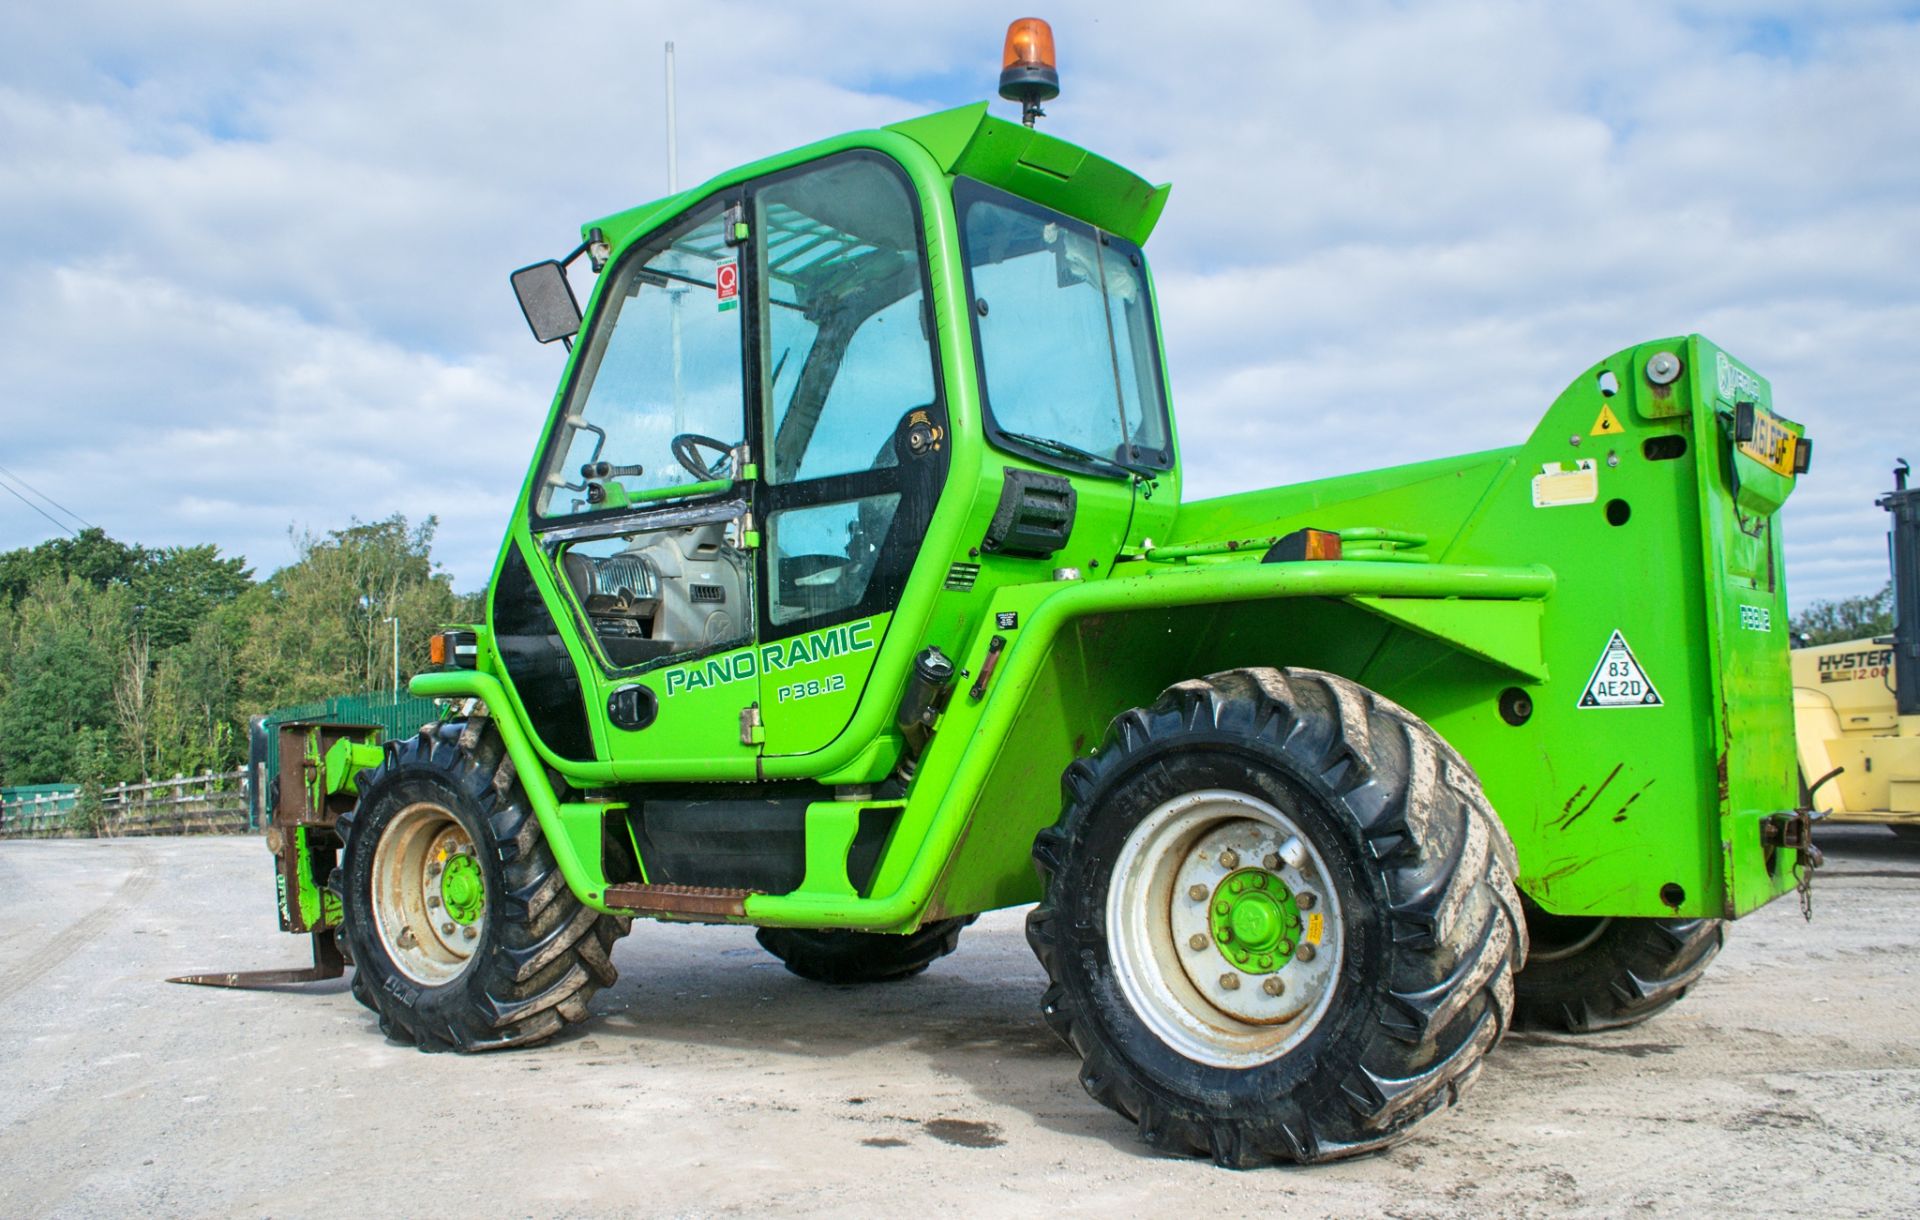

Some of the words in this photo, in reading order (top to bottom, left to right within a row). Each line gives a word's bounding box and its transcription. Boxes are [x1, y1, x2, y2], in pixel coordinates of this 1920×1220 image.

[666, 620, 874, 697] PANORAMIC
[1609, 661, 1629, 677] 83
[1818, 649, 1893, 671] HYSTER
[778, 674, 846, 703] P38.12
[1598, 680, 1641, 697] AE2D
